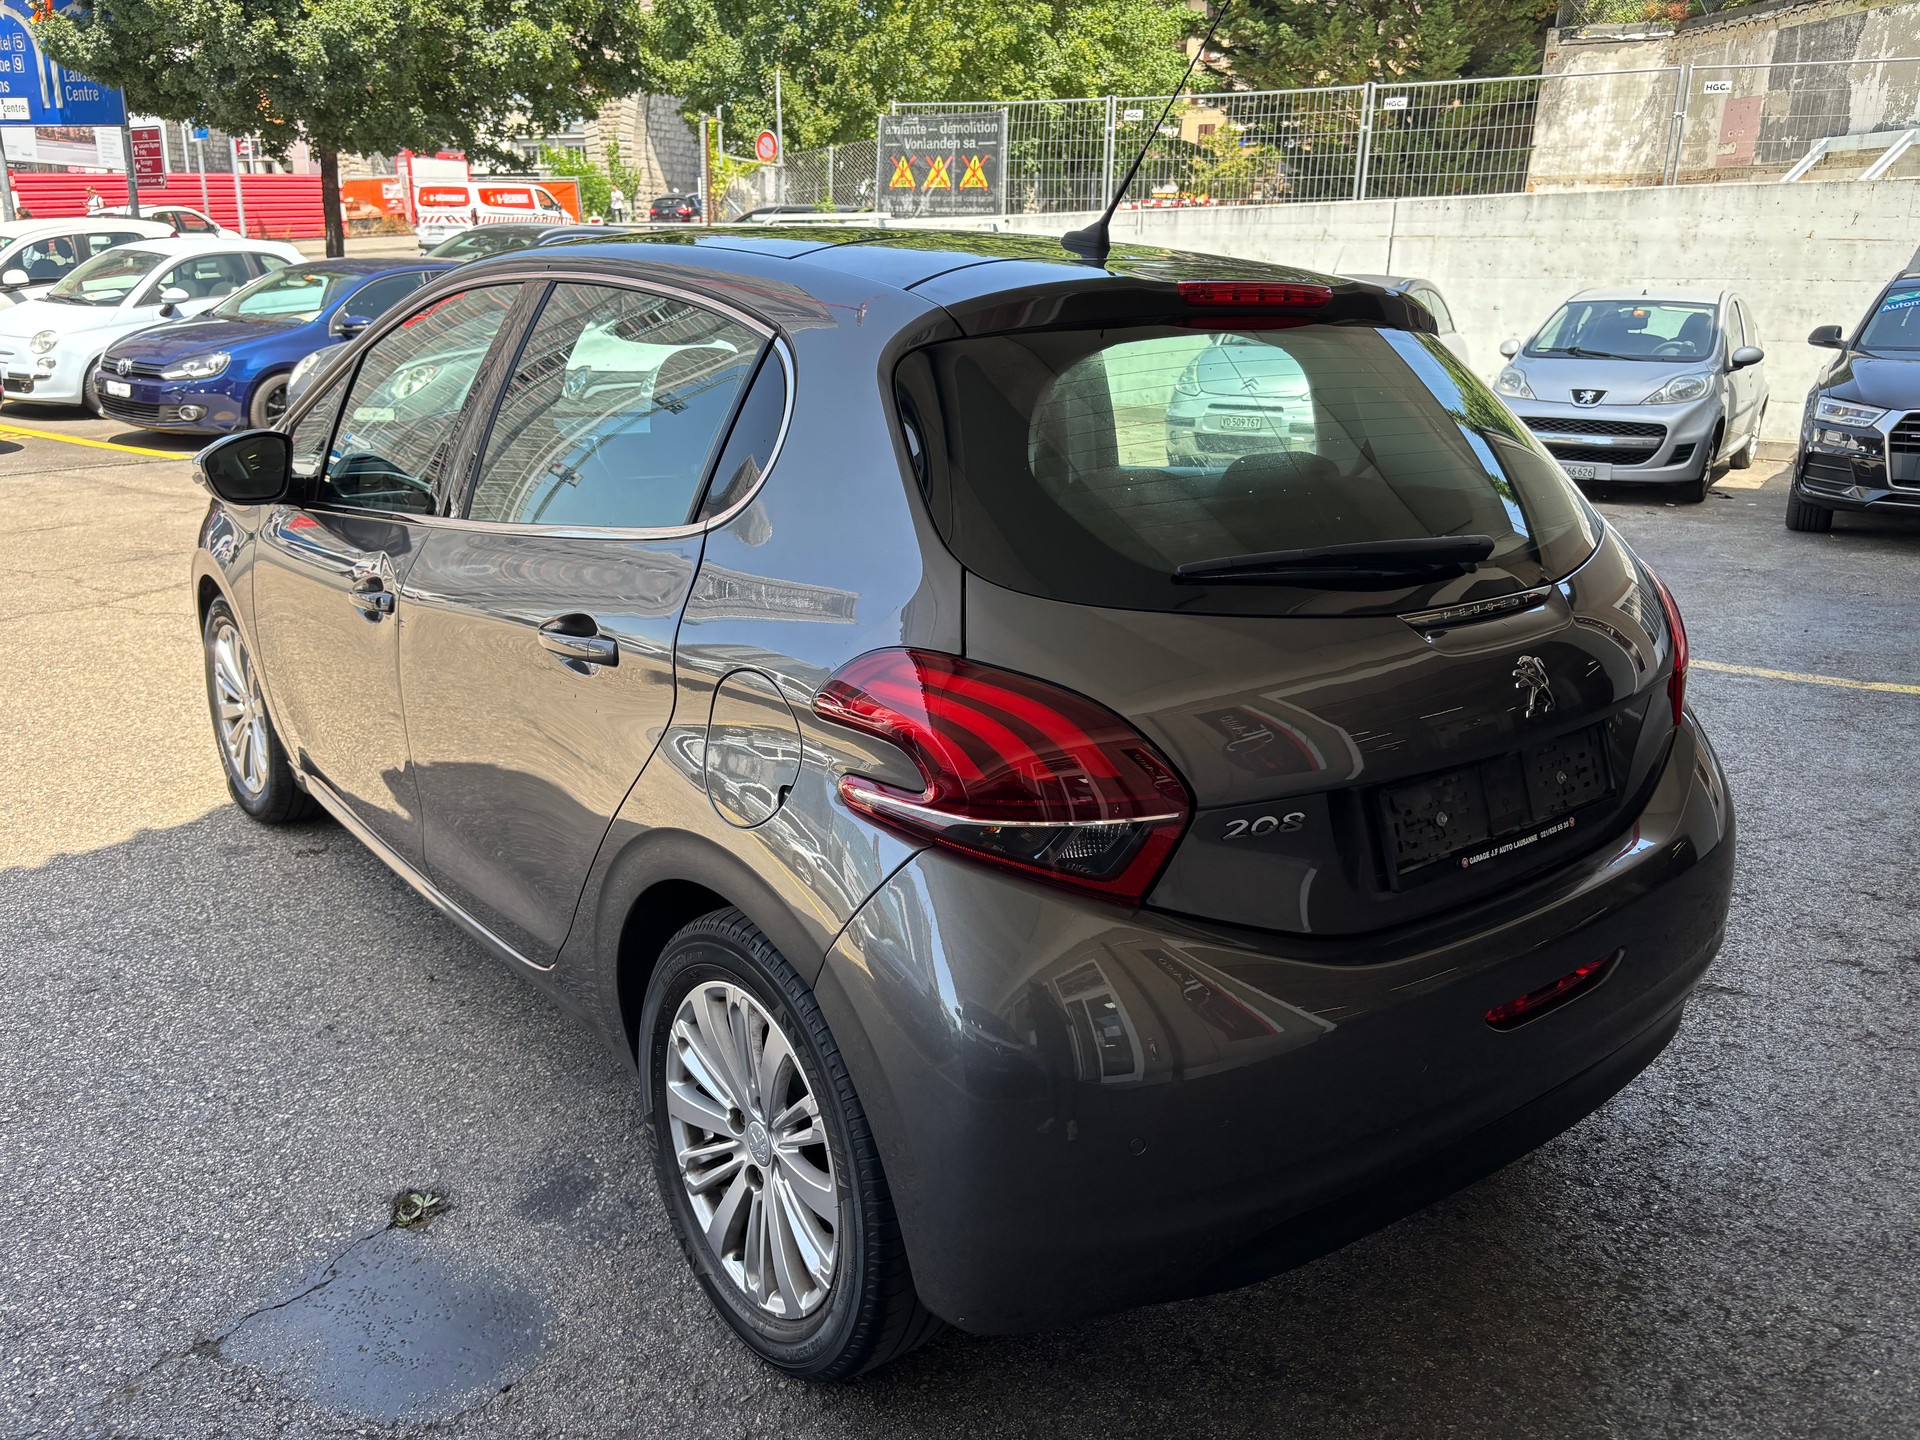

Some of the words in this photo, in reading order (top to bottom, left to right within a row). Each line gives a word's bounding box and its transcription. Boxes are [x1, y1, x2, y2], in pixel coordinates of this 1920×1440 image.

[14, 57, 22, 71] 9
[65, 85, 100, 102] Centre
[885, 124, 927, 135] amiante
[940, 120, 998, 134] démolition
[903, 137, 961, 150] Vonlanden
[1577, 467, 1593, 477] 626
[1441, 593, 1532, 619] PEUGEOT
[1223, 811, 1306, 840] 208
[1469, 851, 1490, 865] GARAGE
[1499, 843, 1513, 854] AUTO
[1513, 833, 1538, 849] LAUSANNE
